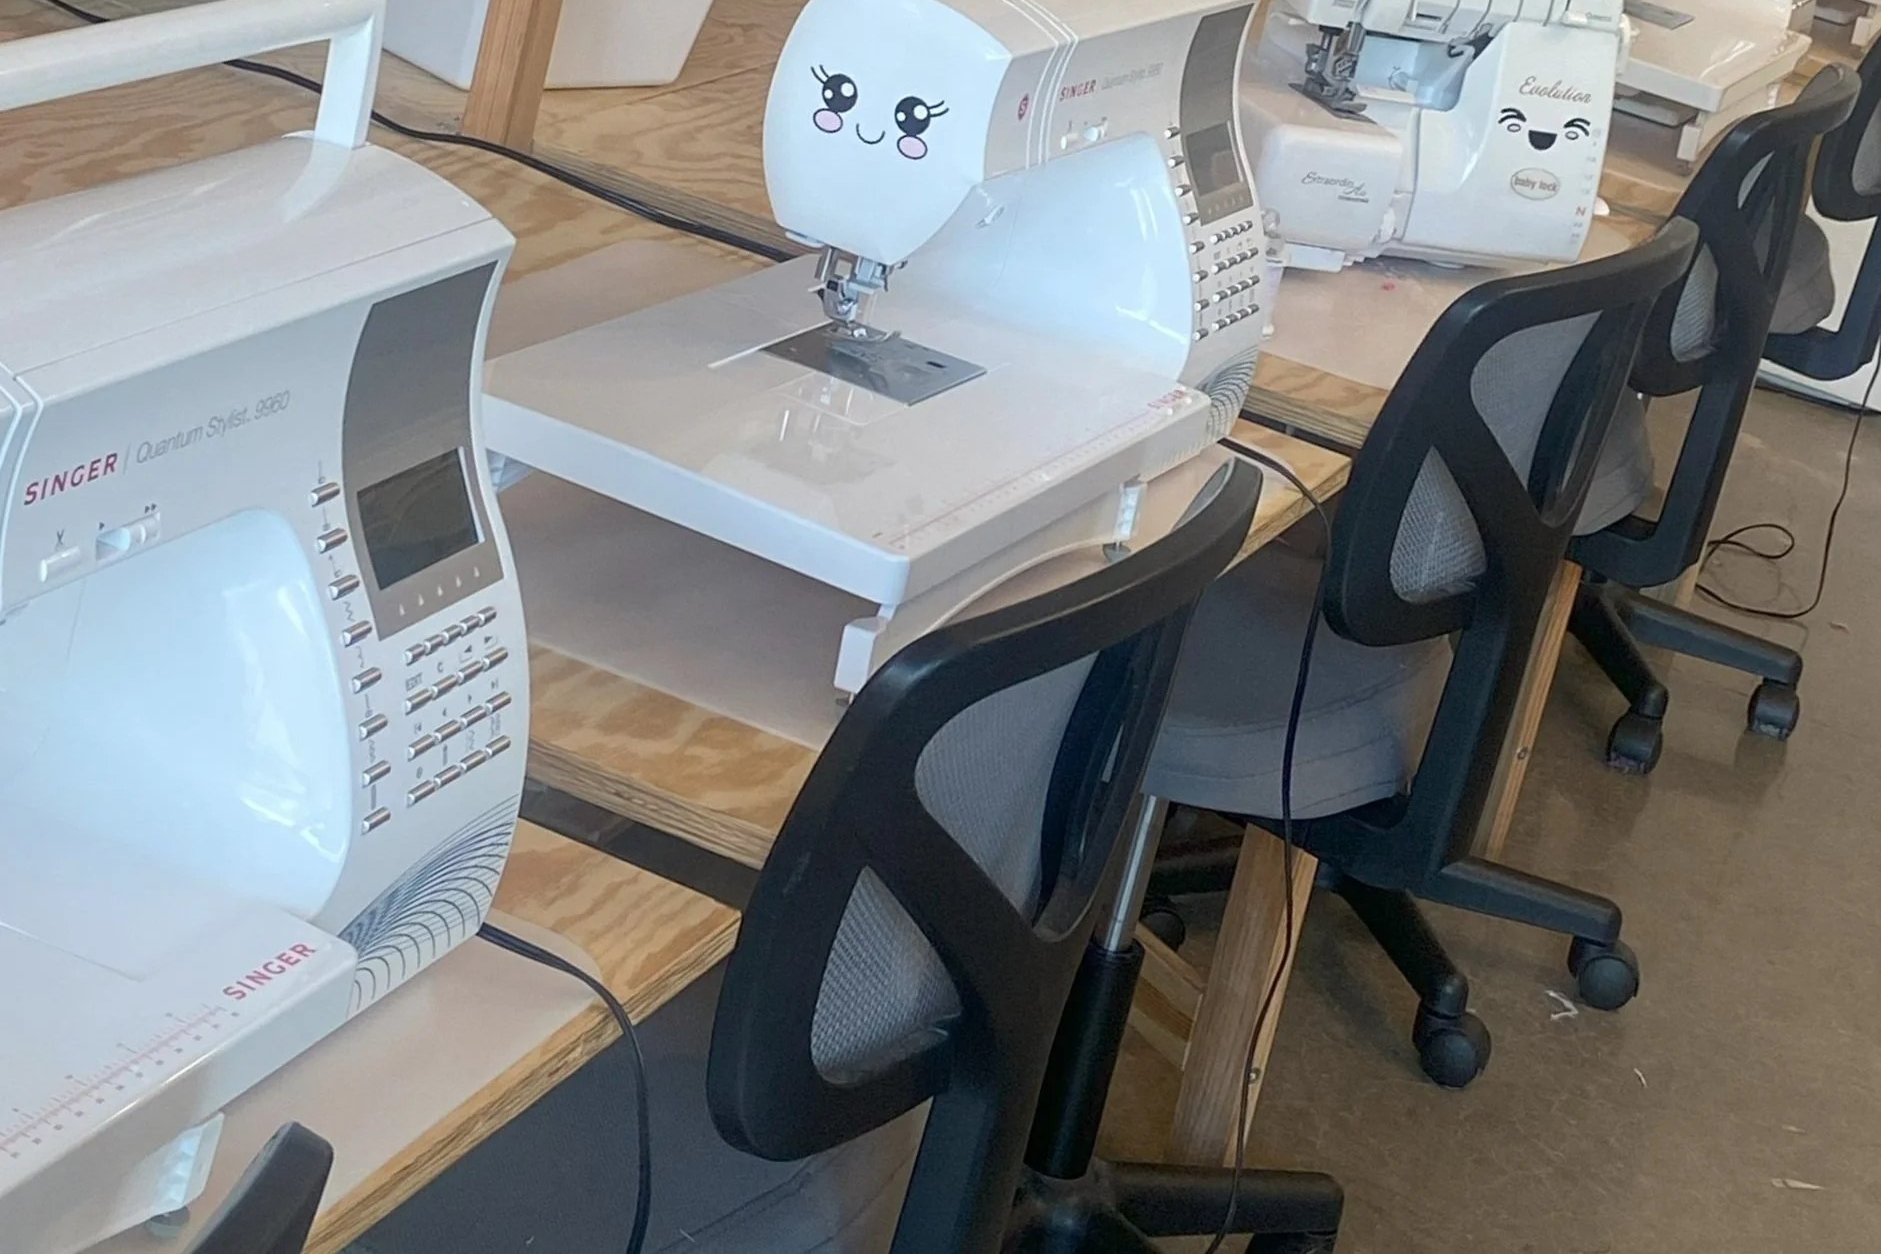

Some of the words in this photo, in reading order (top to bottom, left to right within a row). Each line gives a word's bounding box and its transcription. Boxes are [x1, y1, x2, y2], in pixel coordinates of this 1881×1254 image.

[1059, 79, 1097, 102] SINGER
[1519, 75, 1593, 104] Evolution
[1513, 175, 1538, 192] baby
[1538, 179, 1558, 193] lock
[23, 452, 118, 506] SINGER
[135, 425, 204, 464] Quantum
[253, 389, 292, 421] 9960
[222, 942, 317, 1001] SINGER
